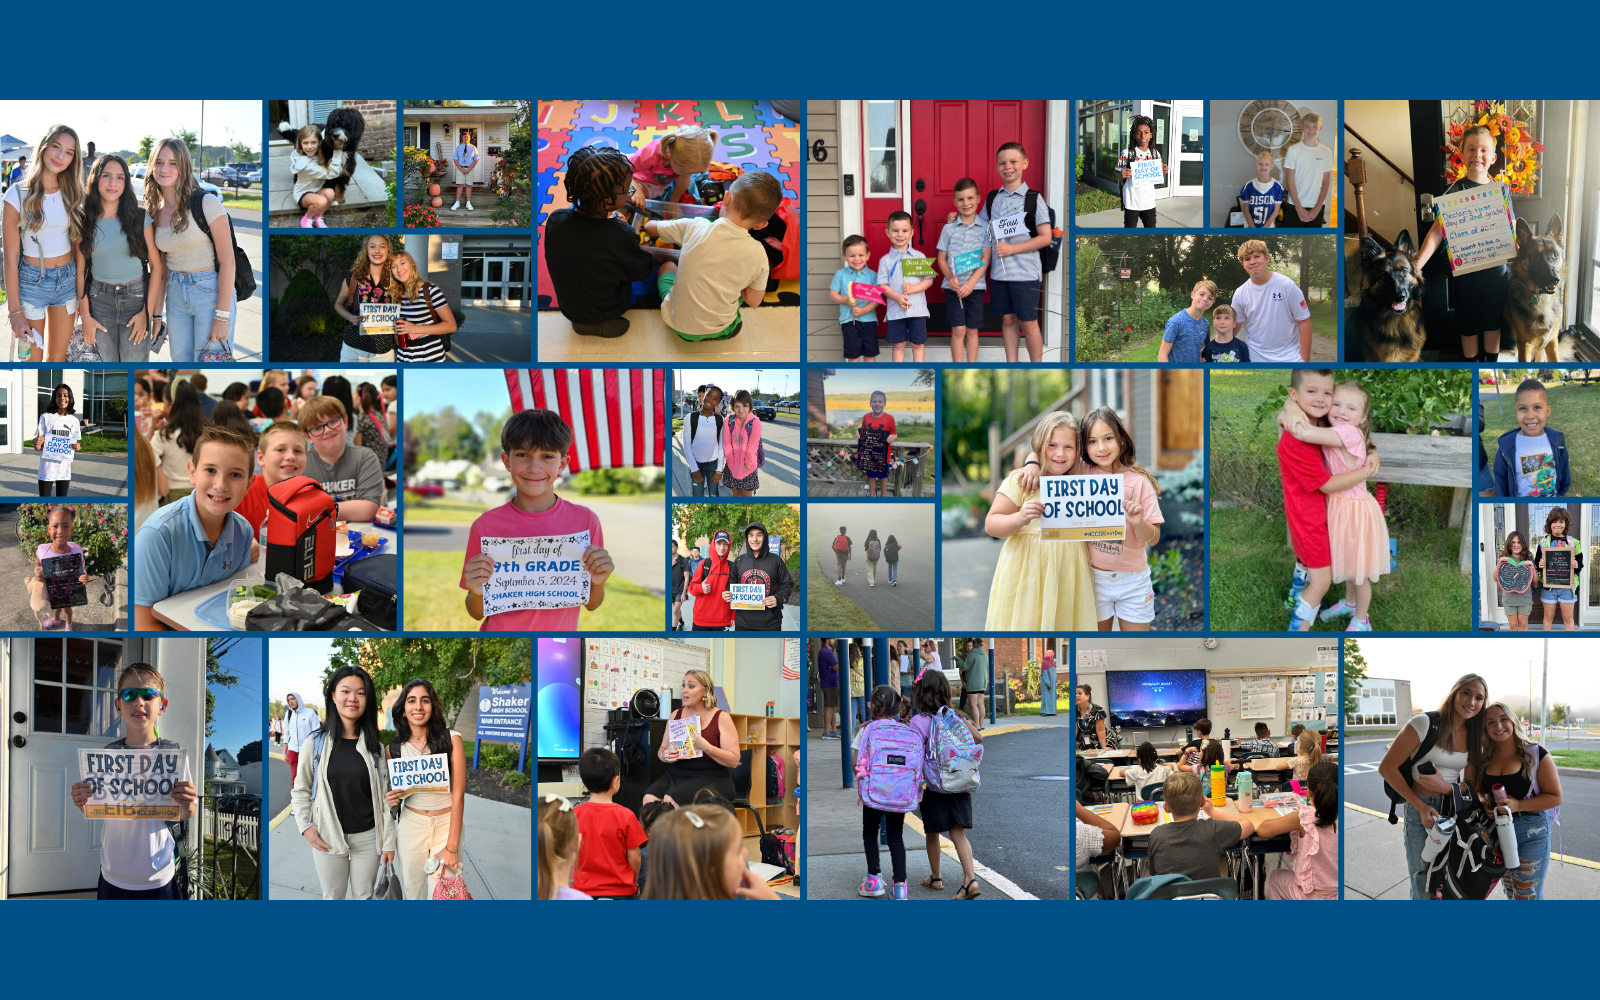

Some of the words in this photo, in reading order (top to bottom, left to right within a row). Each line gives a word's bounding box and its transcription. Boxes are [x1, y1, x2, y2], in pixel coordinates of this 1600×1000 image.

[656, 102, 684, 122] K
[715, 101, 744, 121] L
[720, 132, 758, 159] S
[1134, 172, 1162, 180] SCHOOL
[1450, 230, 1468, 239] Class
[364, 305, 381, 313] FIRST
[383, 304, 397, 313] DAY
[320, 479, 355, 492] HAKER
[1047, 479, 1085, 497] FIRST
[1090, 478, 1118, 496] DAY
[1042, 502, 1061, 518] OF
[1066, 499, 1124, 518] SCHOOL
[512, 545, 531, 559] first
[534, 544, 550, 558] day
[552, 544, 563, 557] of
[526, 560, 580, 572] GRADE
[495, 576, 535, 590] September
[550, 576, 578, 586] 2024
[492, 592, 523, 600] SHAKER
[492, 696, 529, 706] Shaker
[87, 754, 134, 774] FIRST
[140, 754, 177, 774] DAY
[393, 760, 418, 773] FIRST
[421, 757, 442, 770] DAY
[392, 775, 403, 786] OF
[406, 771, 447, 785] SCHOOL
